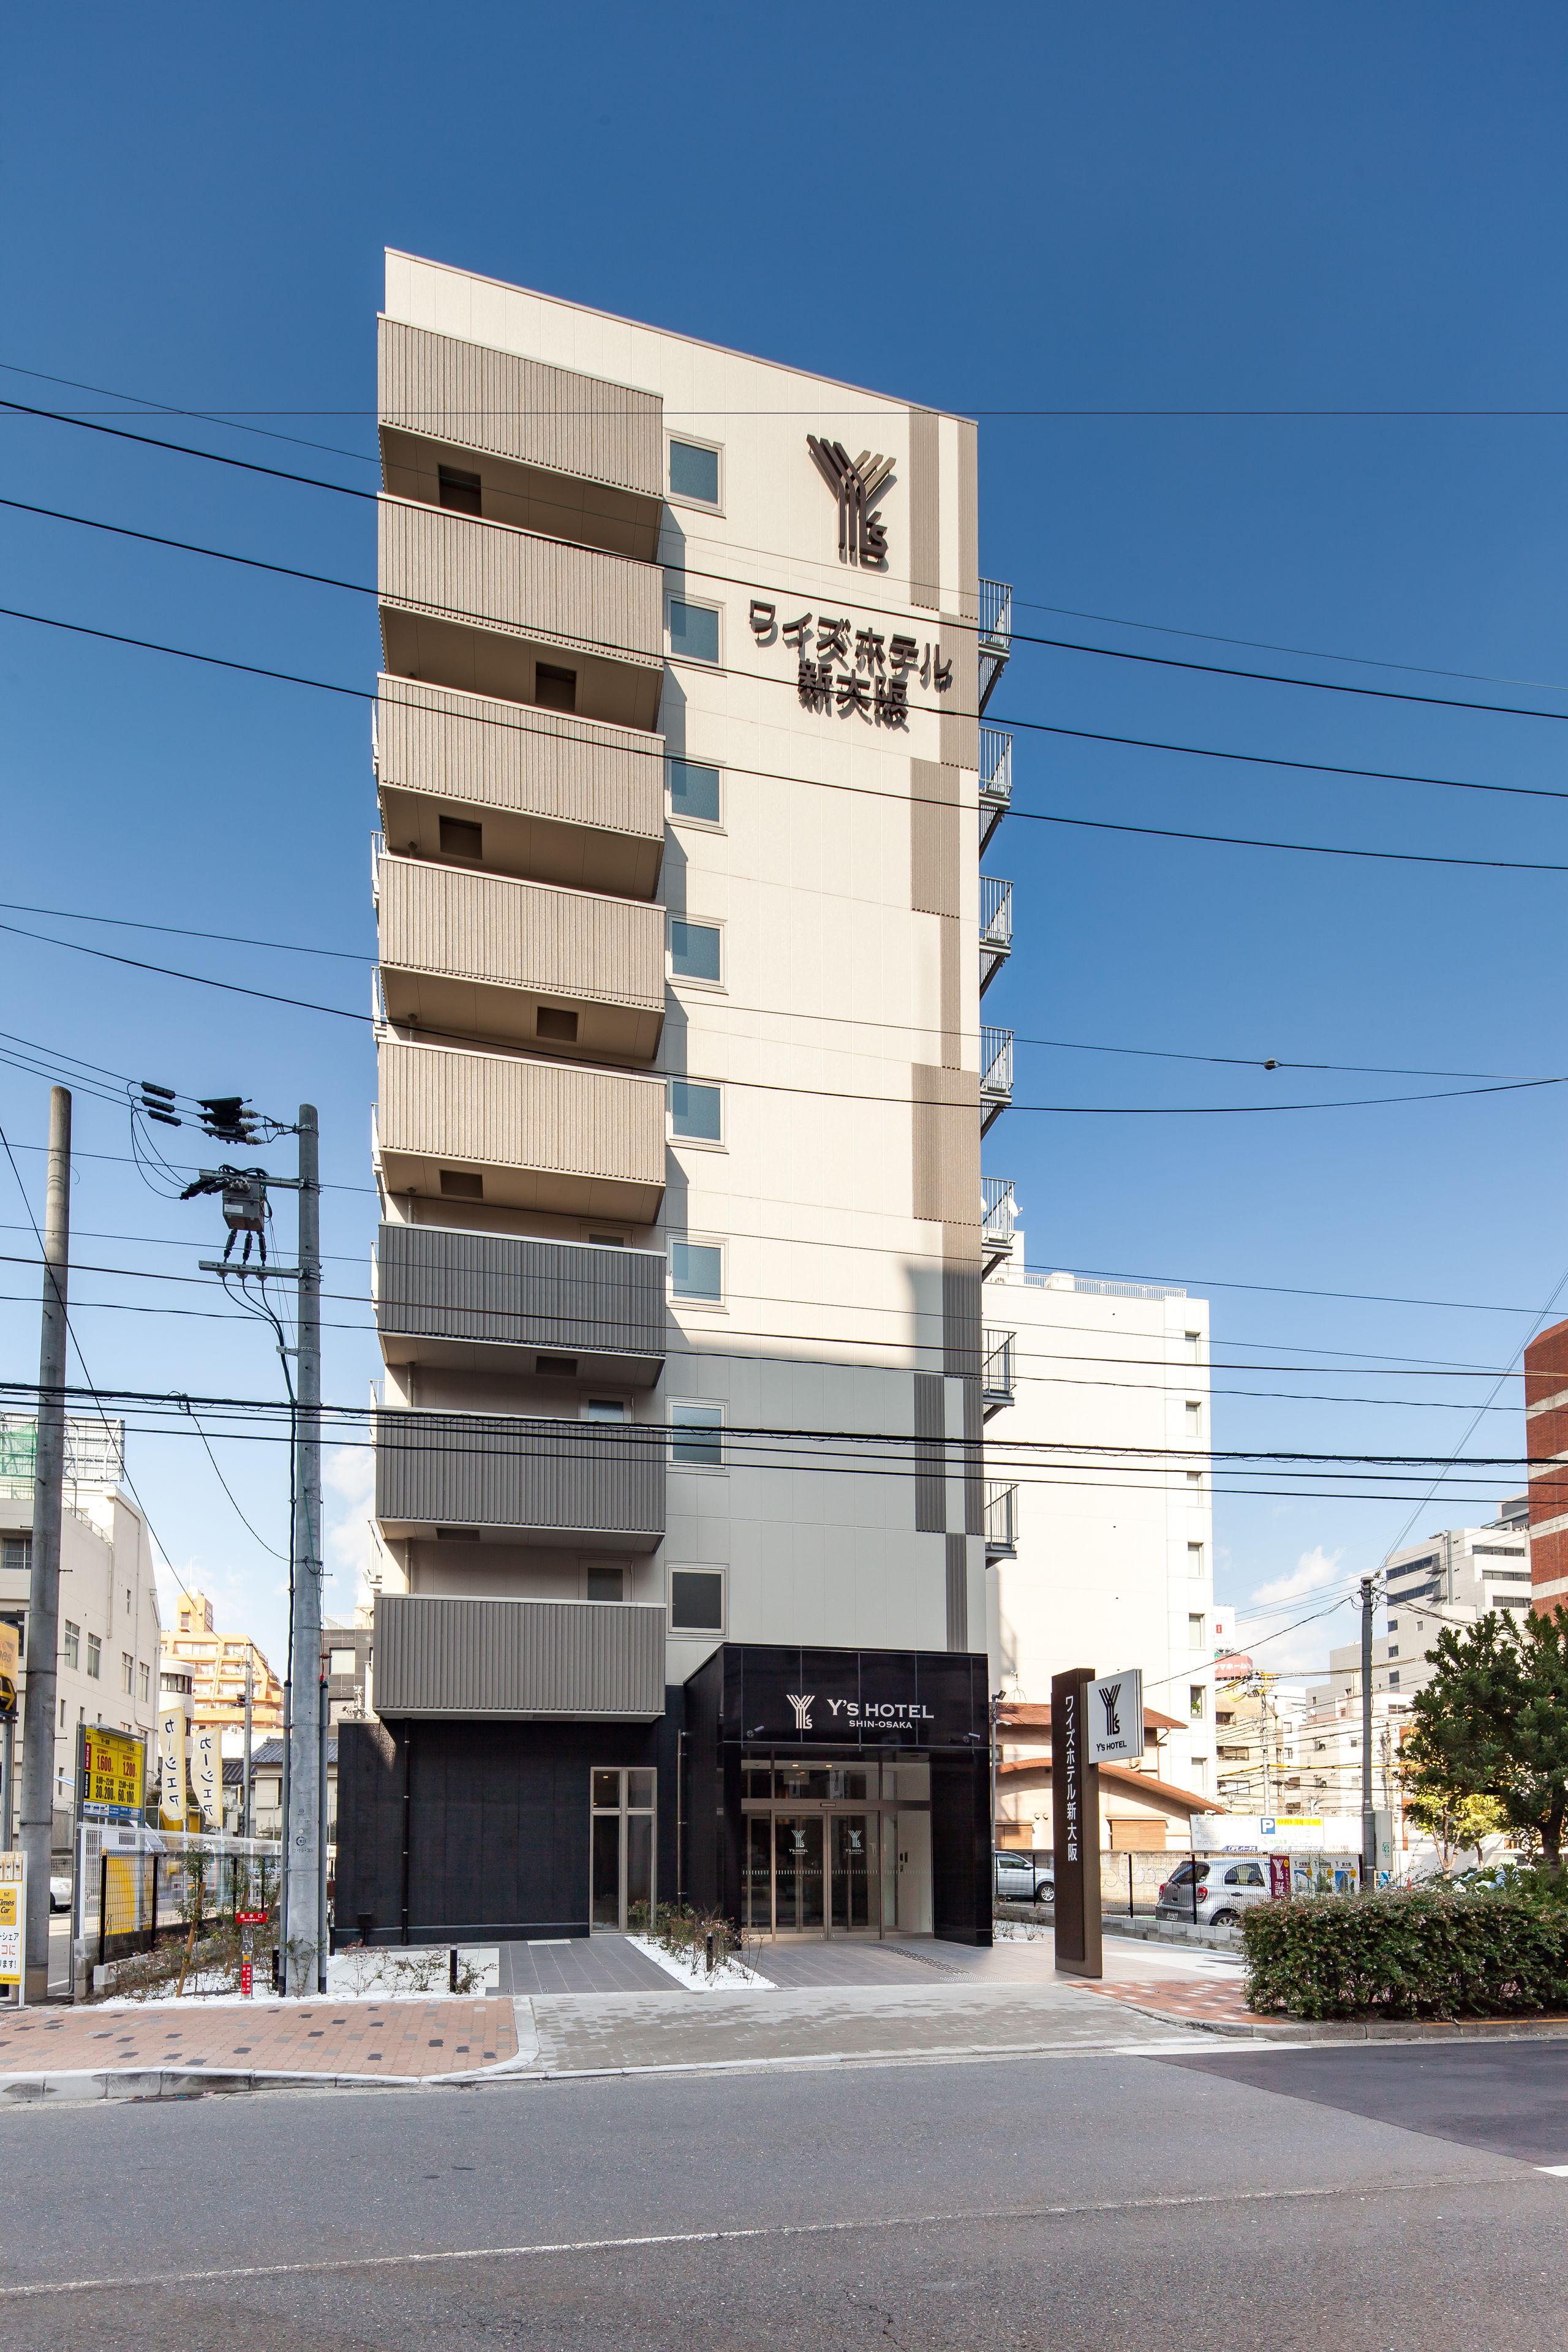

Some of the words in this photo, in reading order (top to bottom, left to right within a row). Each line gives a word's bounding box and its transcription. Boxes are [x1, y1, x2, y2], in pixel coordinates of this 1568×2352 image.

[749, 598, 953, 680] ワイズホテル
[797, 658, 909, 721] 新大阪
[865, 1703, 935, 1719] HOTEL
[849, 1720, 913, 1729] SHIN-OSAKA
[1106, 1741, 1127, 1751] HOTEL
[1066, 1695, 1078, 1862] ワイズホテル新大阪
[1262, 1819, 1274, 1833] P
